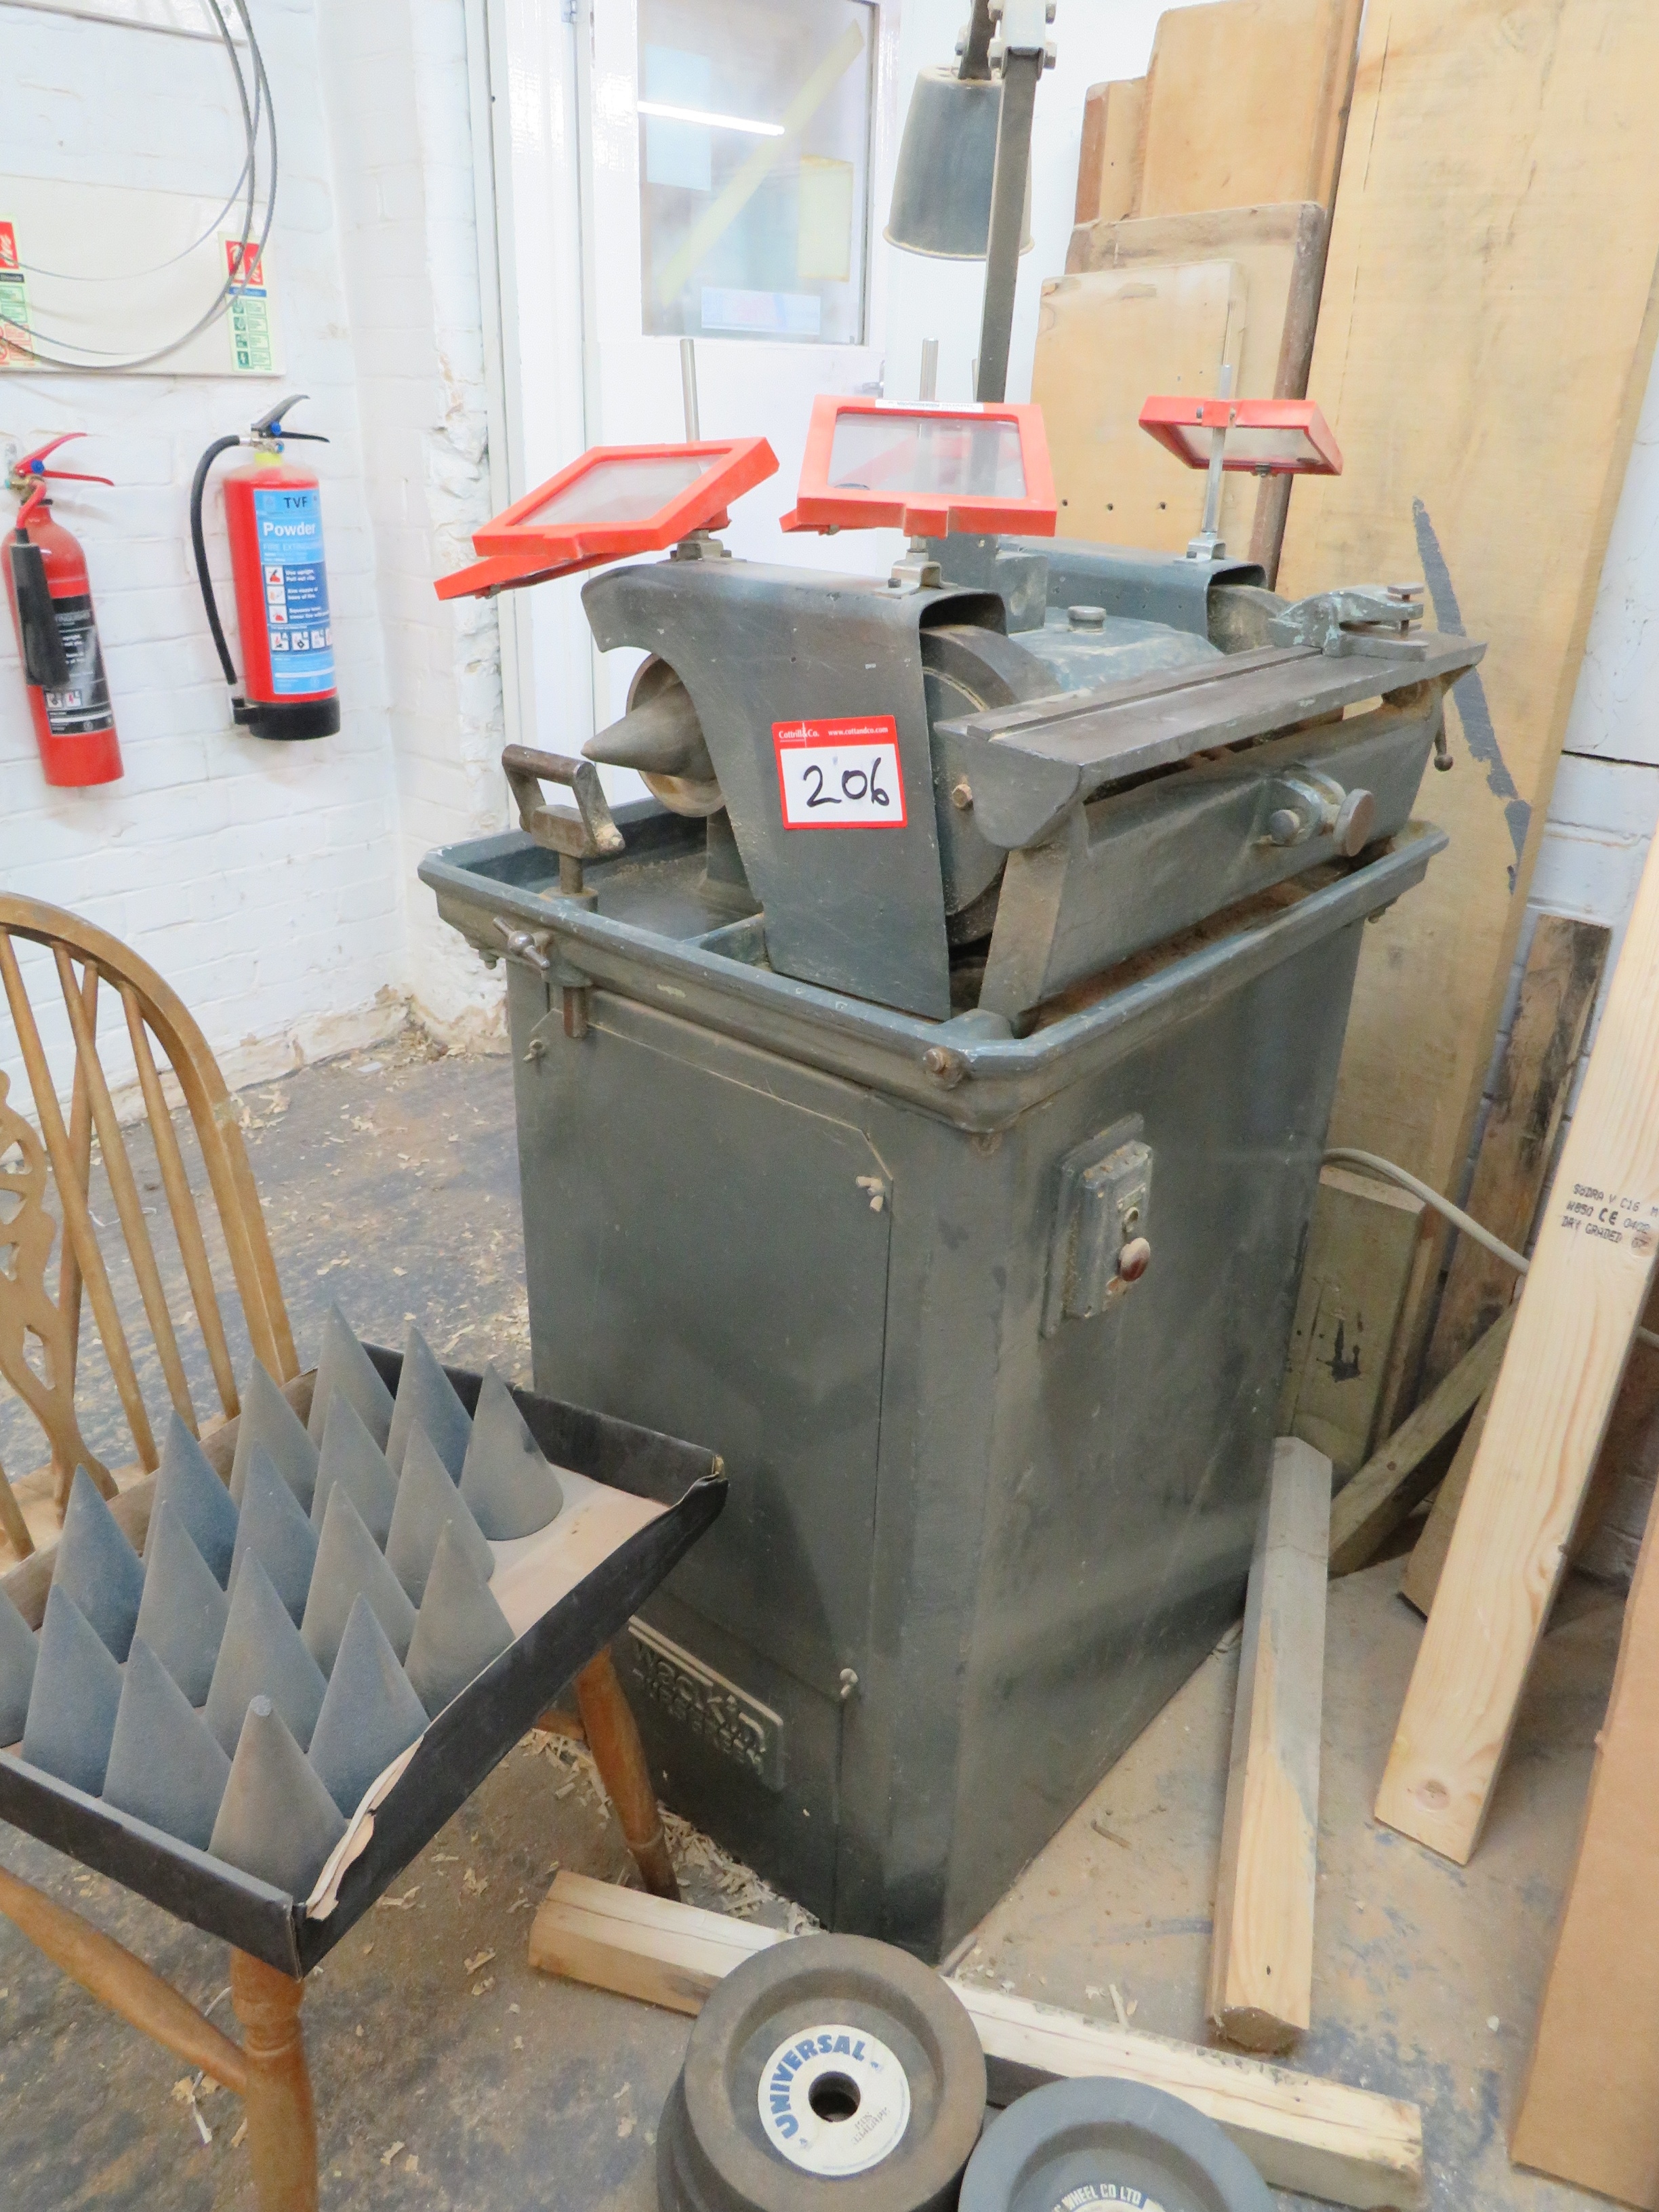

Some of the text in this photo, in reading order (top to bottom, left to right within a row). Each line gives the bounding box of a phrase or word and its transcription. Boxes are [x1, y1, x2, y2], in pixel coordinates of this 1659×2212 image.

[283, 496, 307, 508] TVF
[263, 521, 316, 537] Powder
[827, 726, 888, 737] www.cottandco.com
[802, 757, 890, 808] 206
[1620, 1197, 1641, 1212] C16
[1599, 1208, 1618, 1225] CE
[769, 2034, 866, 2139] UNIVERSAL
[1061, 2183, 1142, 2211] WHEEL CO LTD
